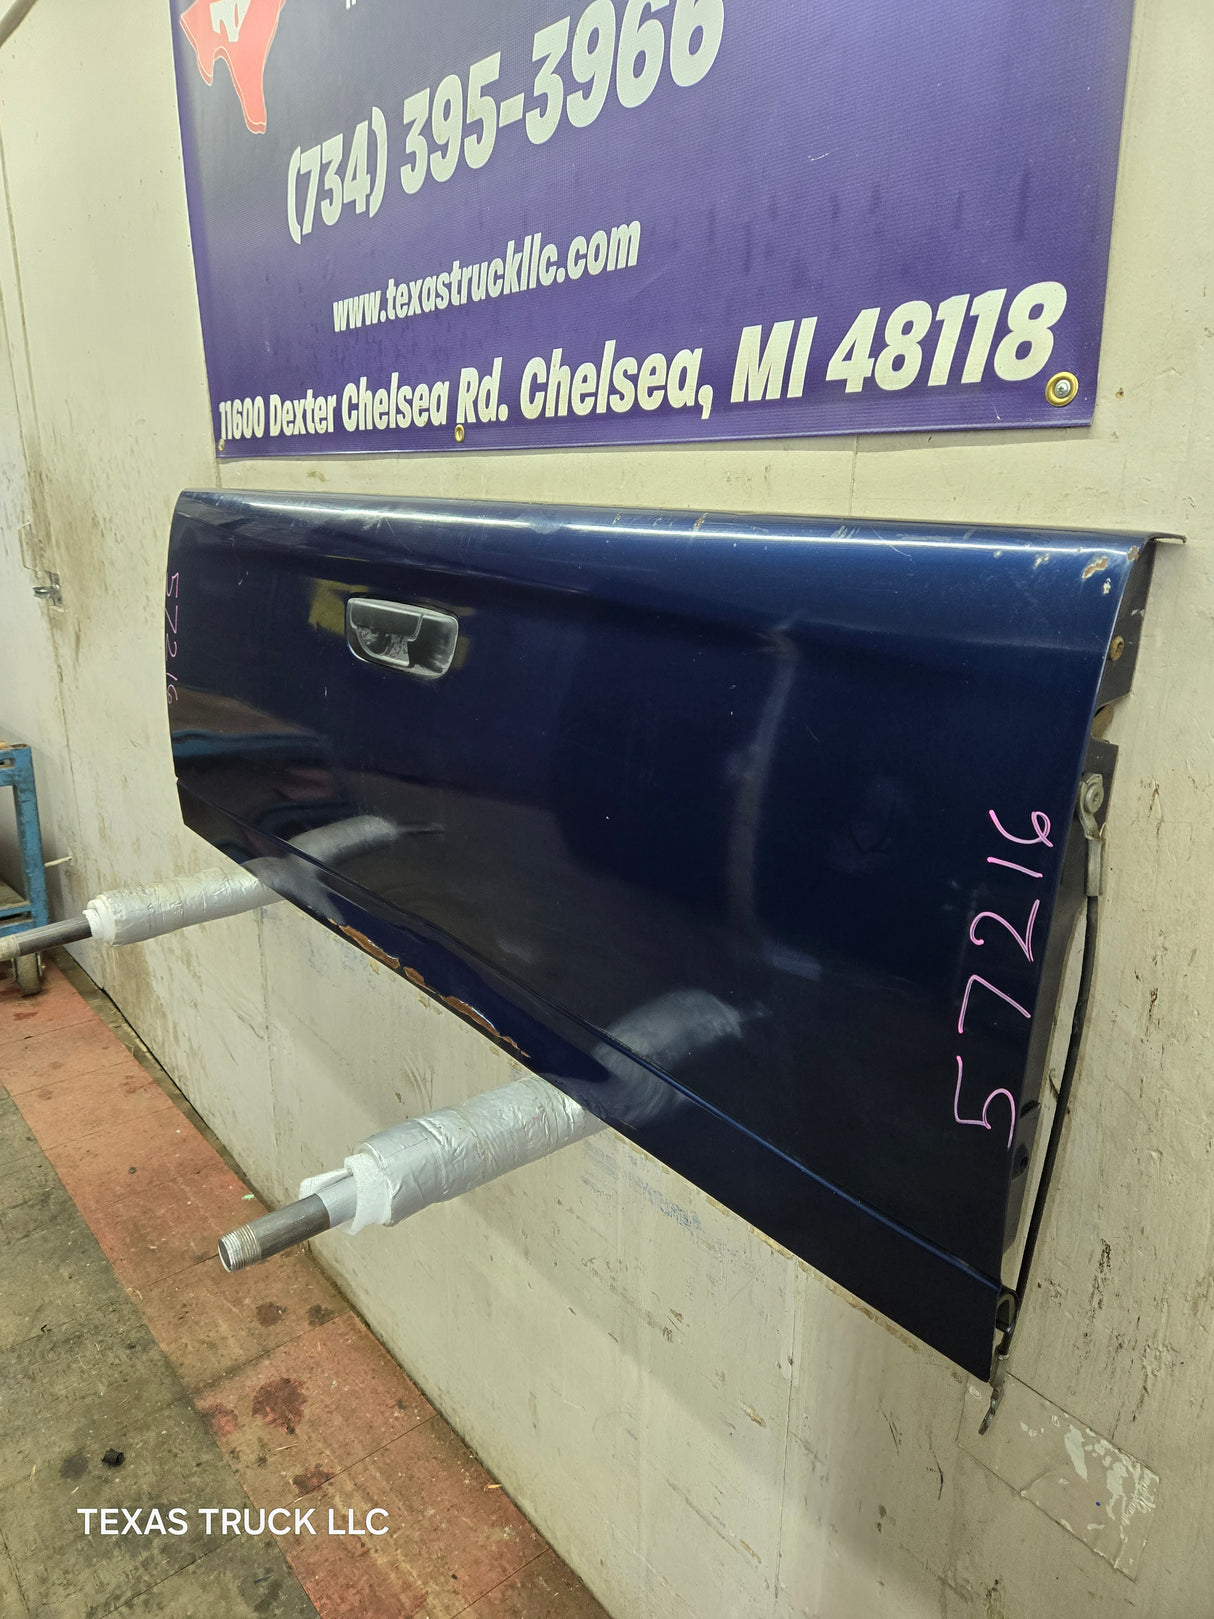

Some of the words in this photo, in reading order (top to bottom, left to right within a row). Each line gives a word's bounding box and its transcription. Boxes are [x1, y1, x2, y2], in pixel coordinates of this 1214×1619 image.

[287, 106, 388, 245] (734)
[400, 0, 725, 194] 395-3966
[218, 395, 265, 440] 11600
[269, 388, 336, 437] Dexter
[341, 372, 450, 434] Chelsea
[455, 357, 509, 423] Rd.
[520, 340, 714, 420] Chelsea,
[730, 316, 818, 403] MI
[825, 281, 1068, 393] 48118
[332, 220, 642, 333] www.texastruckllc.com
[954, 809, 1054, 1149] 57216
